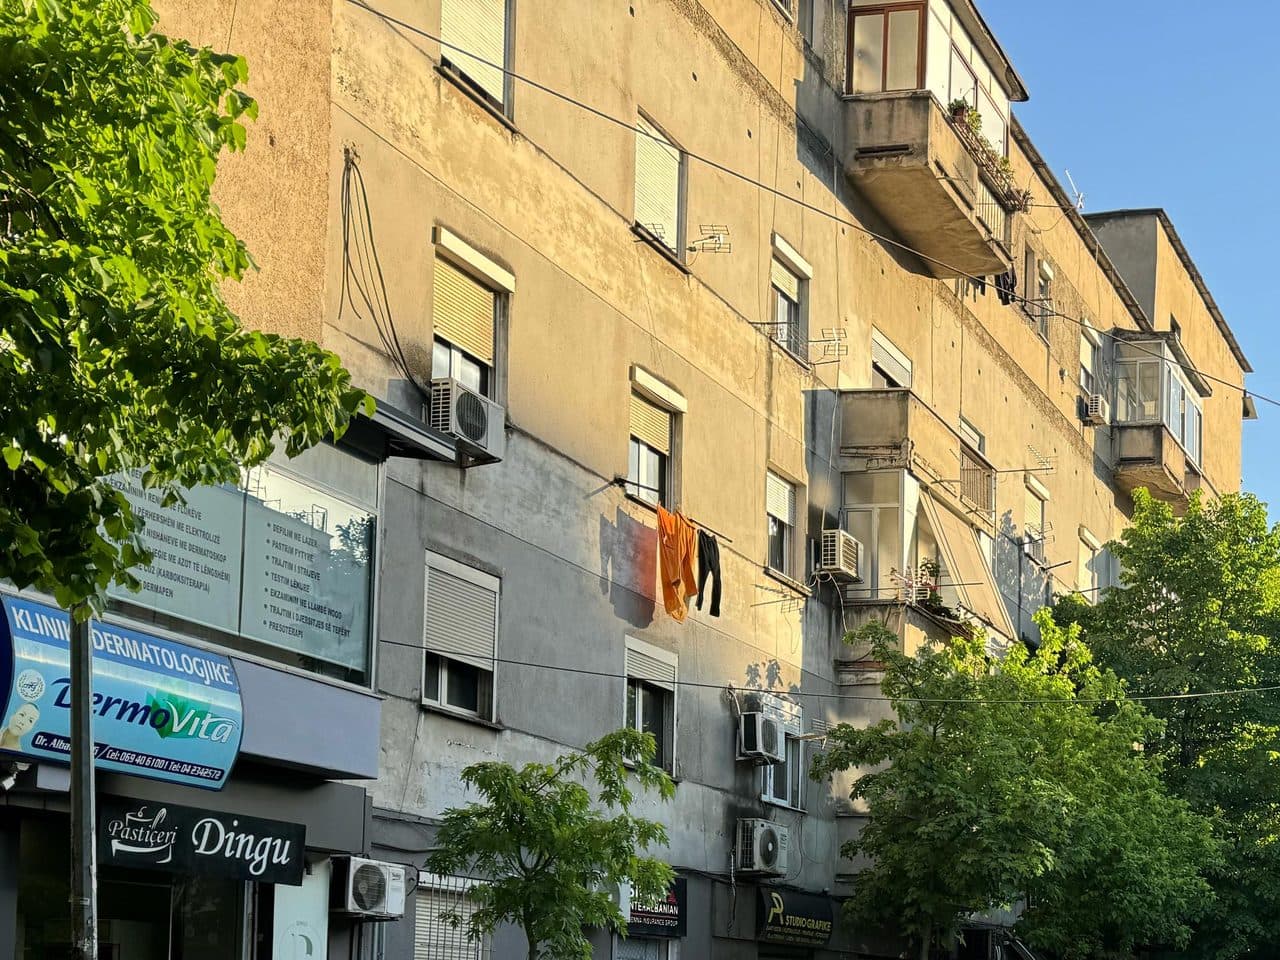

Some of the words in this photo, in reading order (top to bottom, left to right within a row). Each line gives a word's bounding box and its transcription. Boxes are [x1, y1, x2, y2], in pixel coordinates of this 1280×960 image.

[92, 629, 234, 686] DERMATOLOGJIKE
[34, 734, 48, 747] Dr.
[135, 754, 146, 765] 40
[108, 819, 178, 846] Pastiçeri
[191, 817, 291, 876] Dingu
